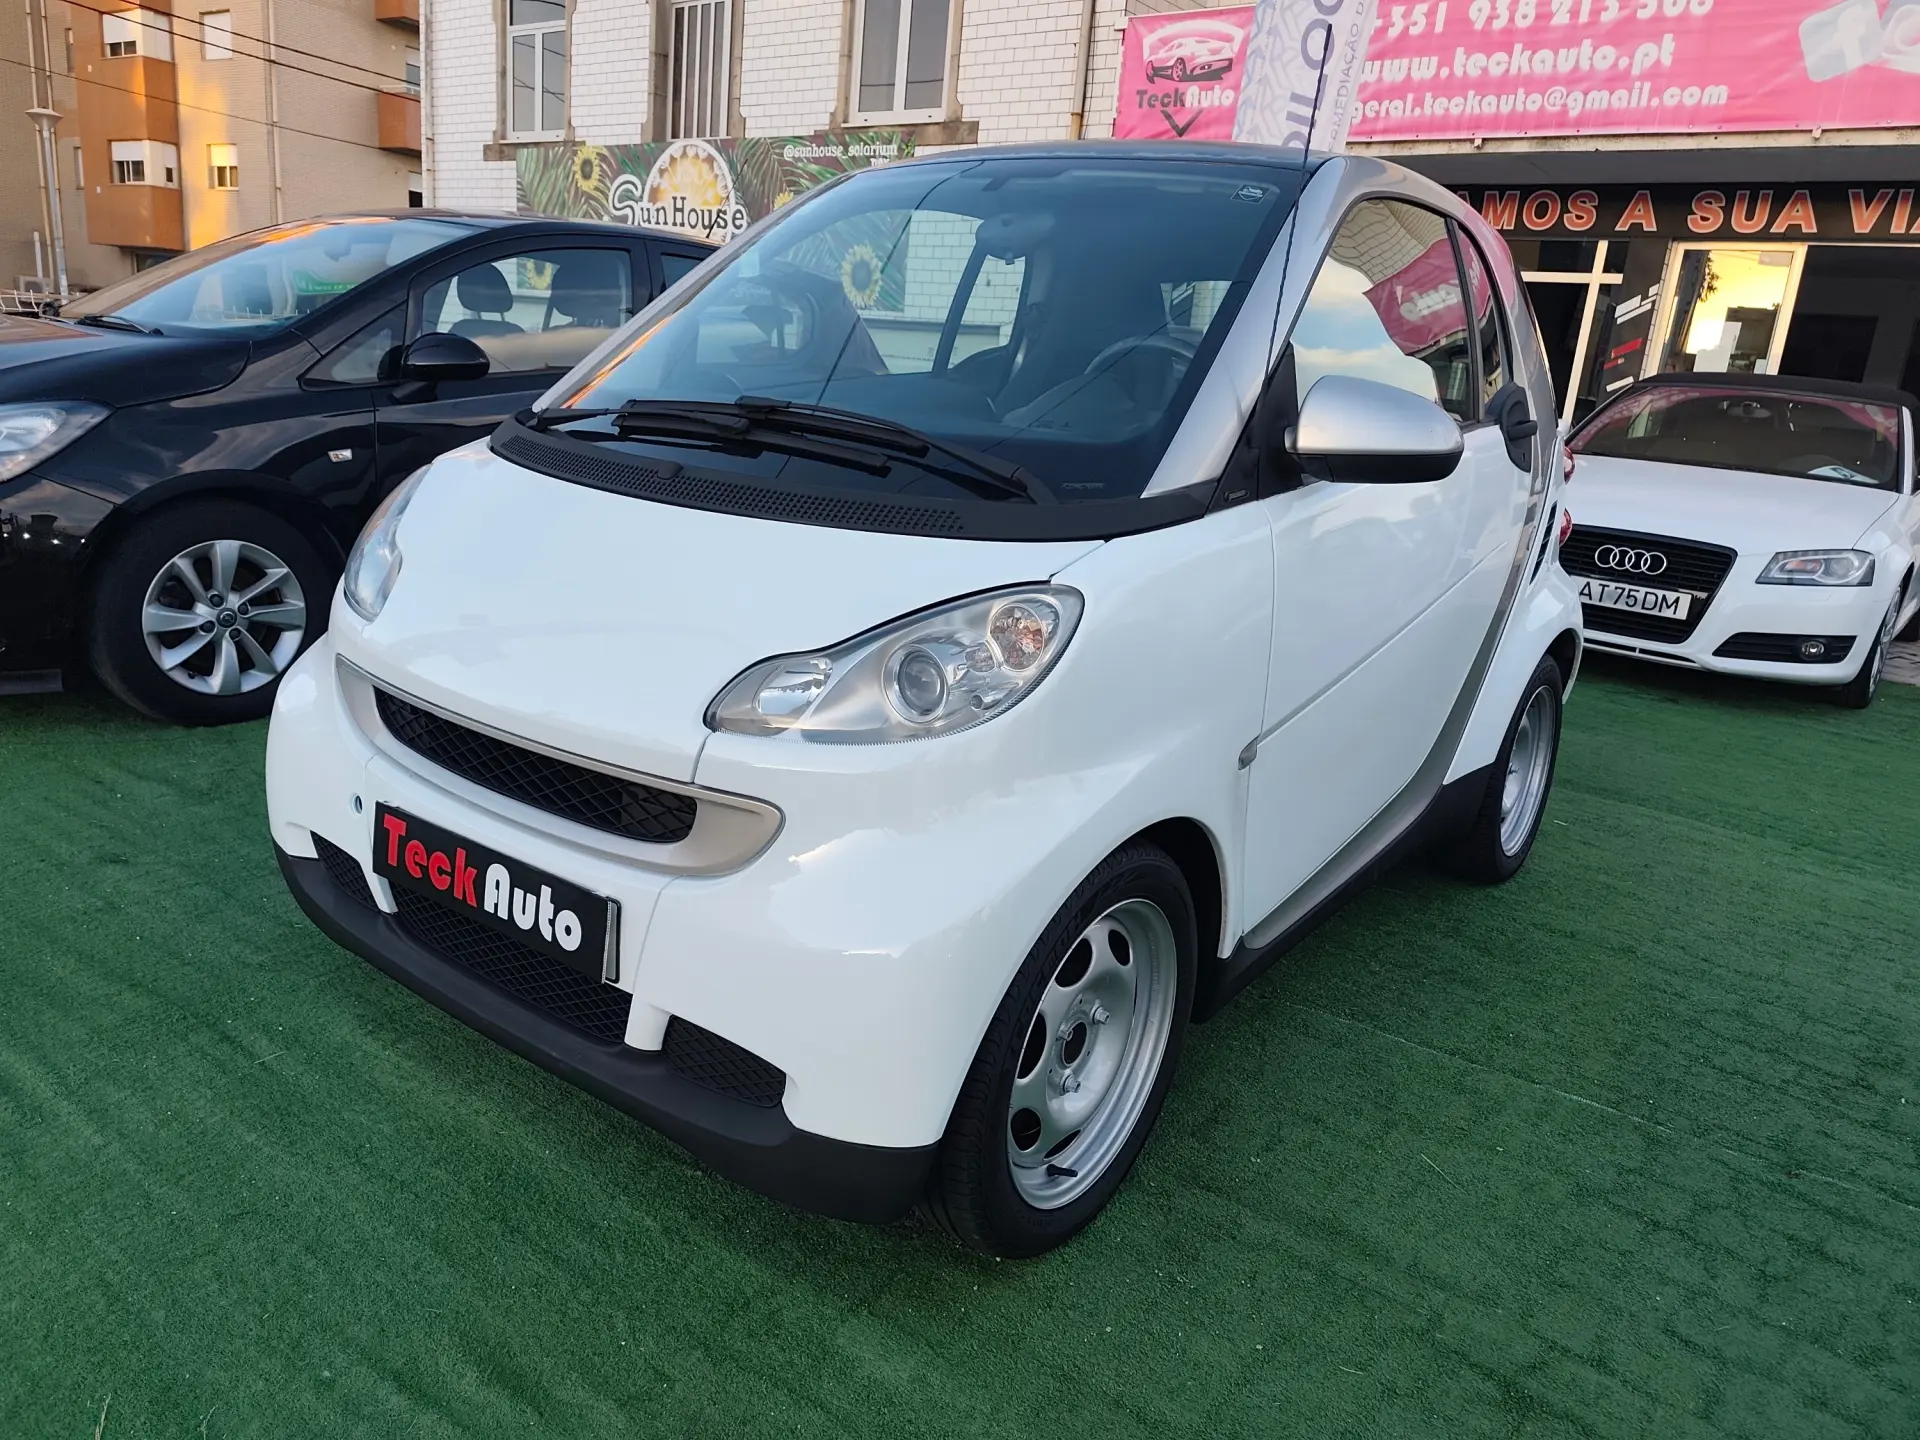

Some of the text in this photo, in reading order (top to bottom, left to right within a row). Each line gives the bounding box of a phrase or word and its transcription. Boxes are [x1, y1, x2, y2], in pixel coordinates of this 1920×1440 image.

[1360, 33, 1676, 84] www.teckauto.pt
[1351, 82, 1729, 124] geral.teckauto@gmail.com
[783, 139, 899, 161] @sunhouse_solarium
[1614, 191, 1657, 232] A
[1686, 189, 1818, 234] SUA
[1847, 188, 1920, 234] VI
